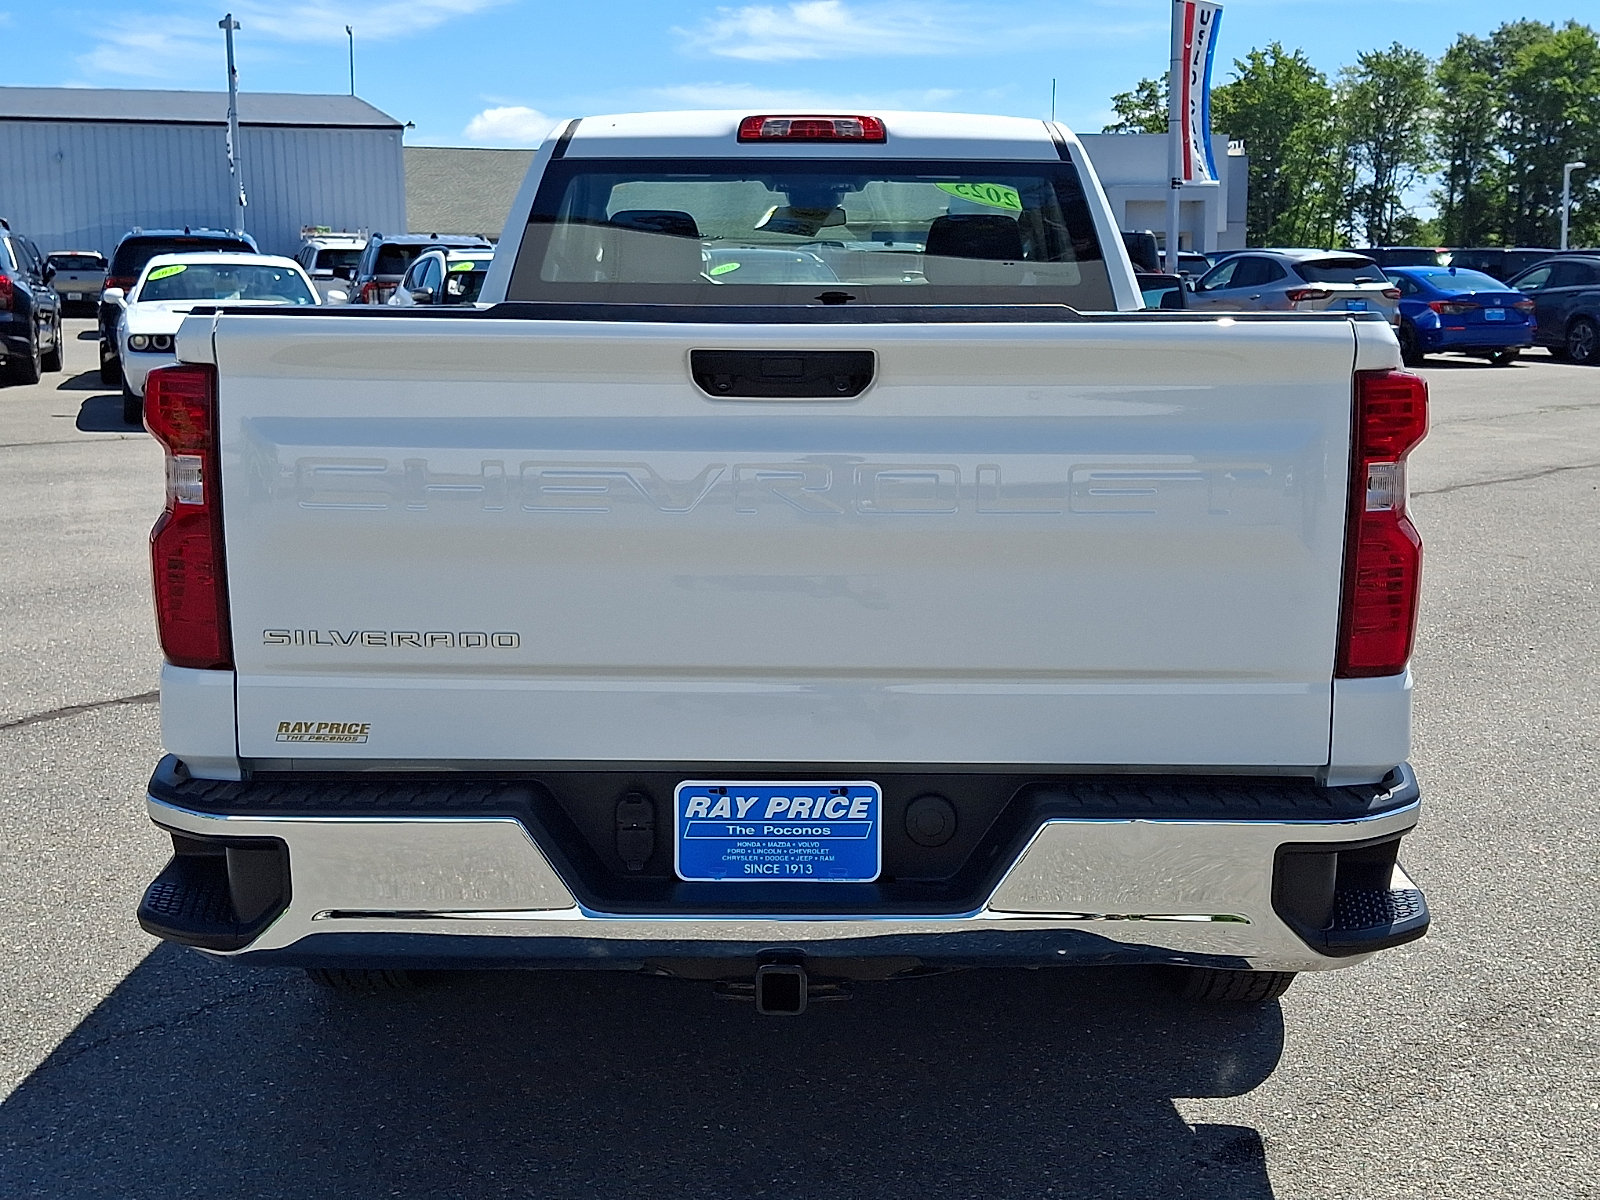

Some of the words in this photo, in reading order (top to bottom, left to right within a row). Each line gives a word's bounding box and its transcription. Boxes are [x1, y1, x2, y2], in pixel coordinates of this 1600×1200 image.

[296, 457, 1275, 517] CHEVROLET
[262, 629, 521, 649] SILVERADO
[277, 721, 315, 734] RAY
[315, 722, 372, 735] PRICE
[684, 796, 760, 819] RAY
[763, 796, 873, 819] PRICE
[726, 825, 756, 836] The
[763, 825, 832, 836] Poconos
[743, 863, 780, 874] SINCE
[785, 863, 813, 874] 1913
